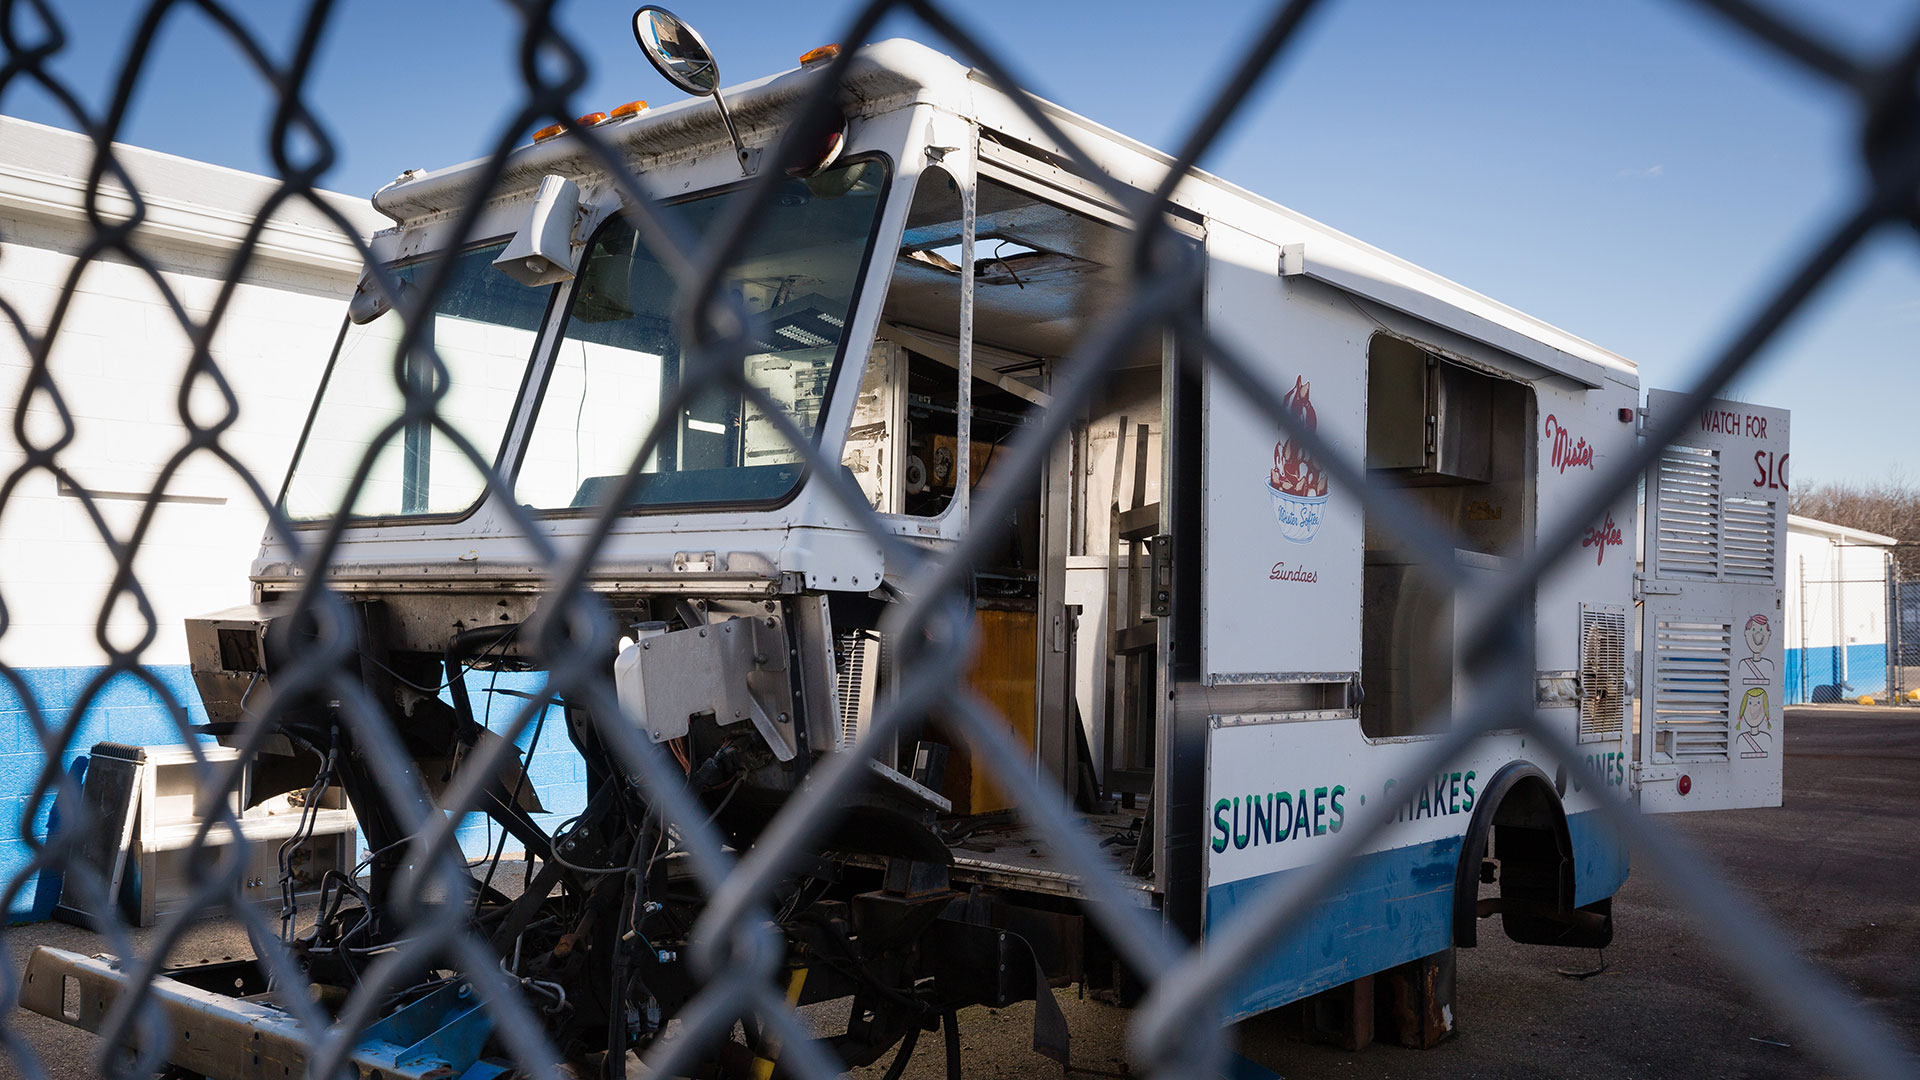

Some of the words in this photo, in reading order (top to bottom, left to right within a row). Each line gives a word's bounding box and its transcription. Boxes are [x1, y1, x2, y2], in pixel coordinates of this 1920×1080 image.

[1544, 414, 1593, 474] Mister
[1701, 410, 1740, 435] WATCH
[1746, 415, 1767, 439] FOR
[1269, 561, 1318, 583] Sundaes
[1211, 785, 1345, 853] SUNDAES
